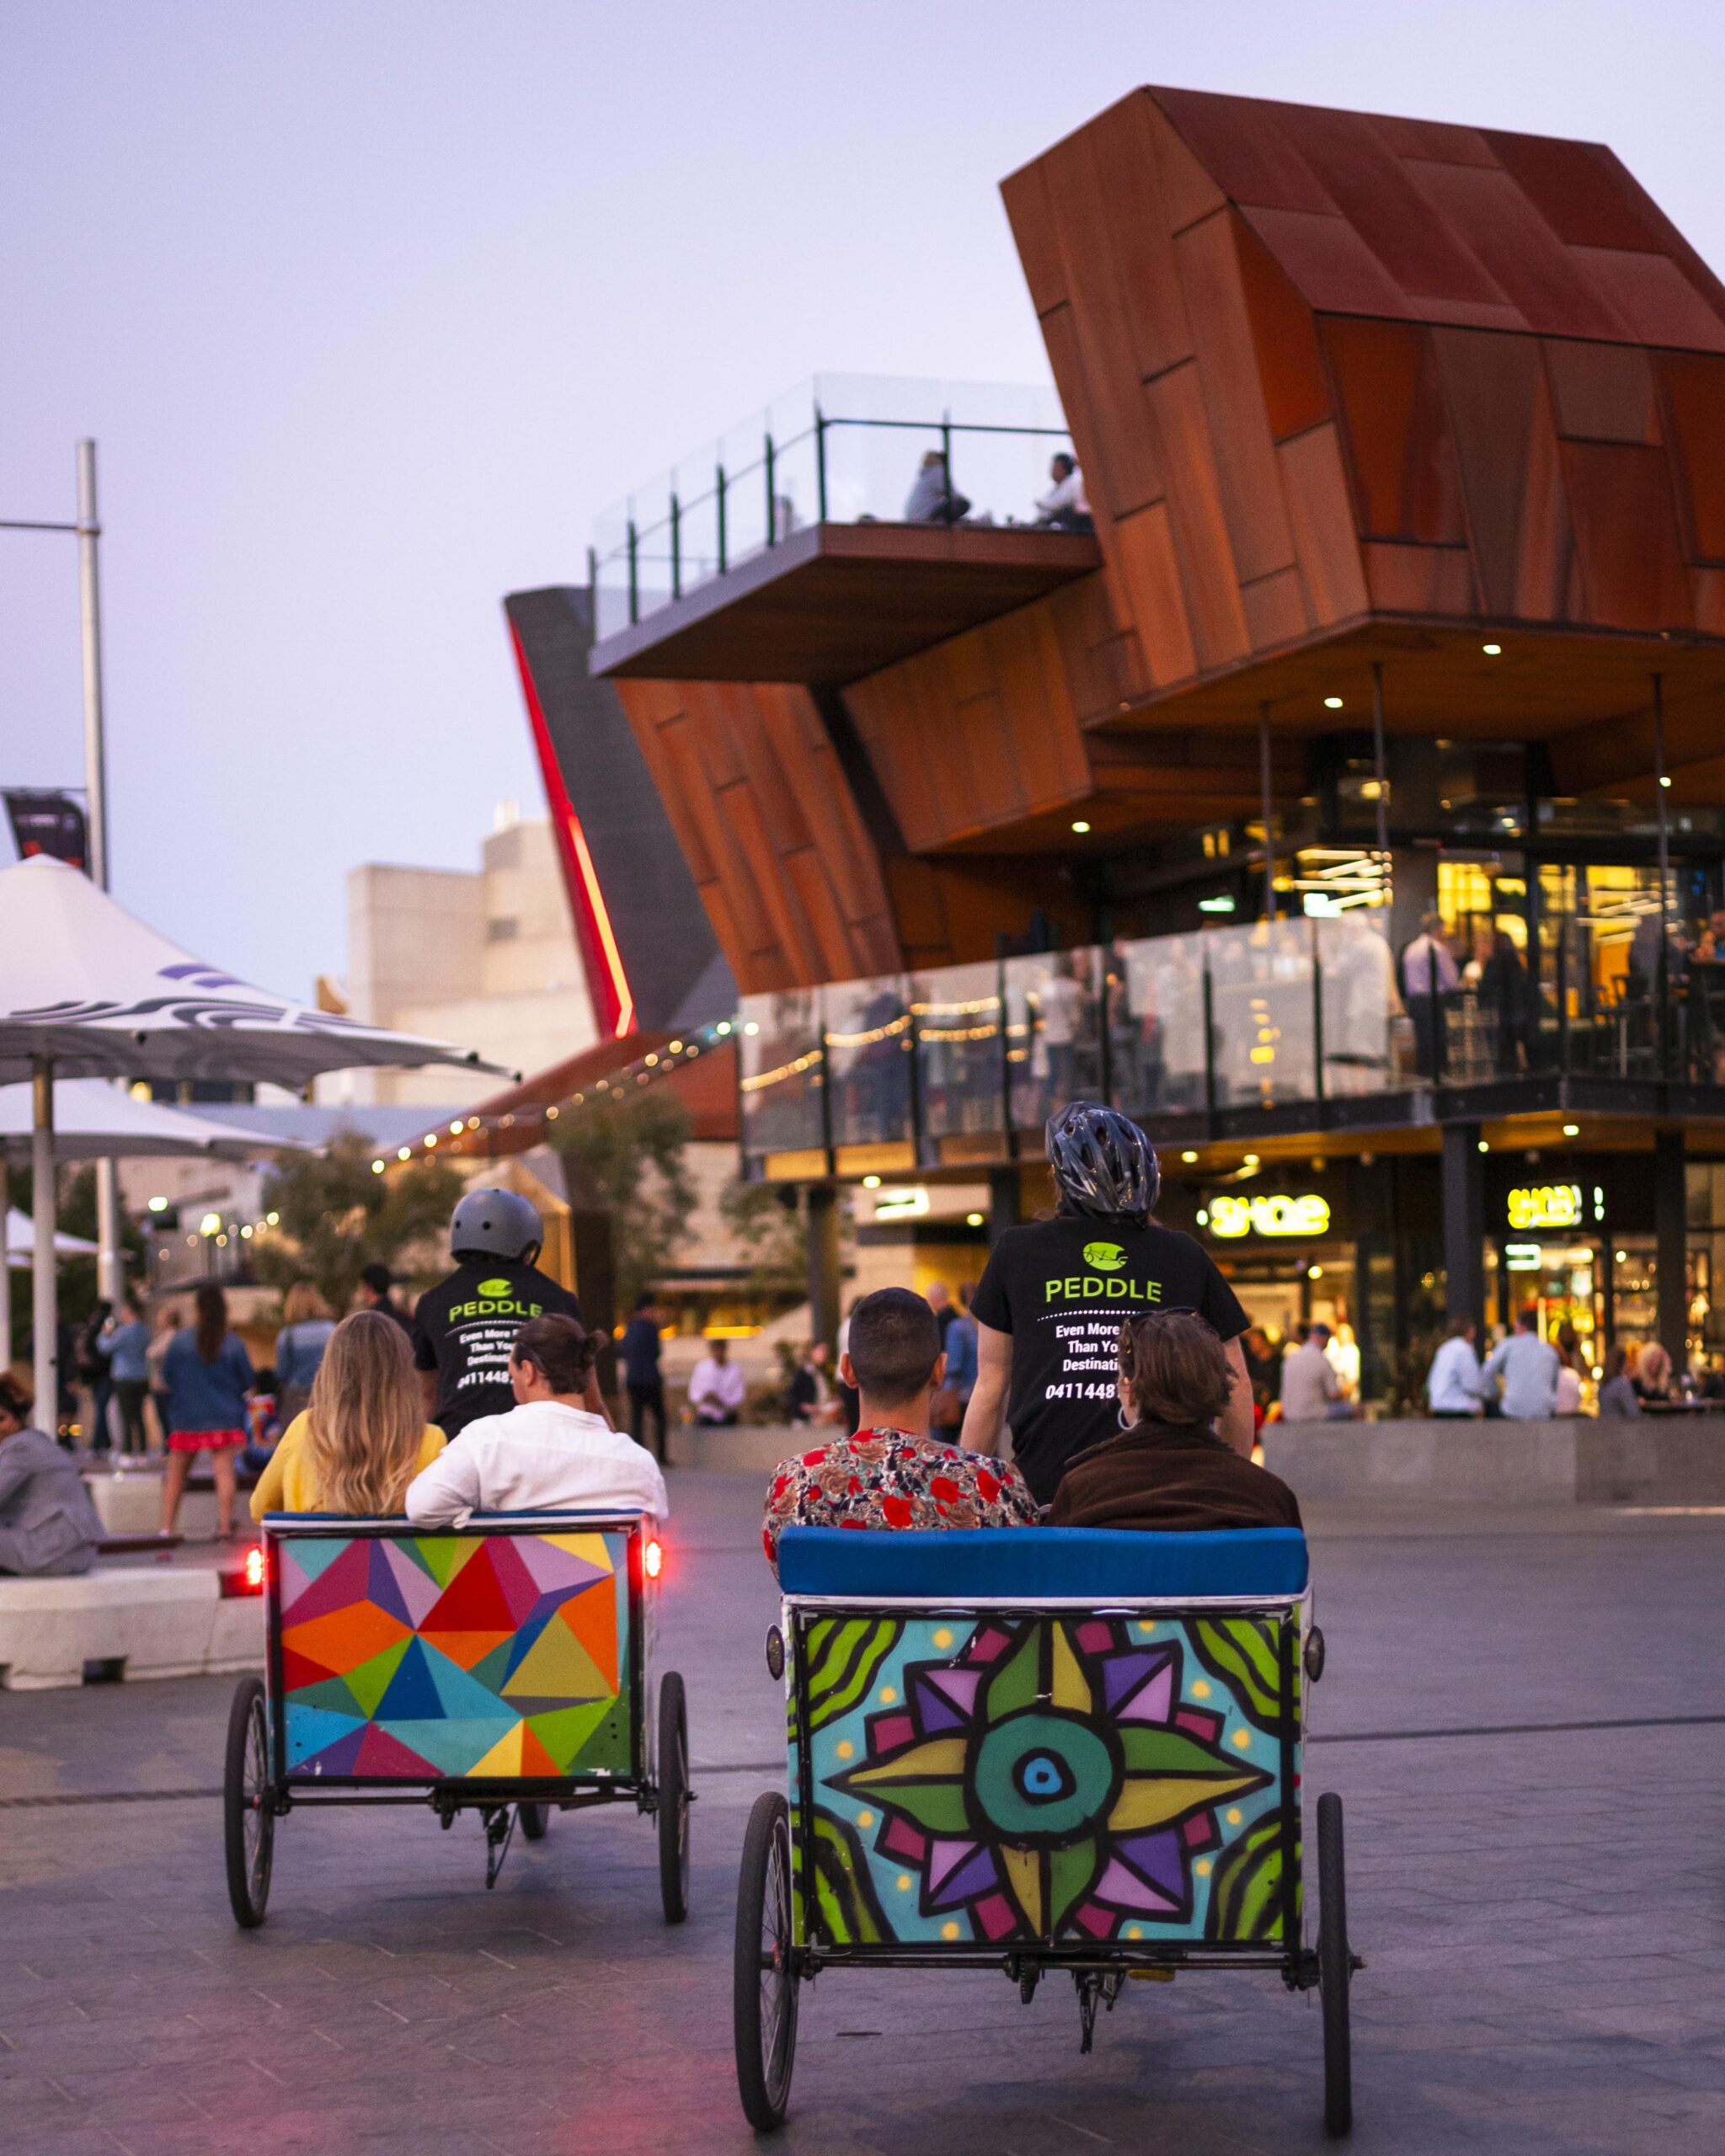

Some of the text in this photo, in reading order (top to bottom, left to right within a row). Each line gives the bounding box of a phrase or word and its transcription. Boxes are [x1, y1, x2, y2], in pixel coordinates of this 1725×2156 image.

[1045, 1277, 1162, 1303] PEDDLE
[448, 1300, 542, 1322] PEDDLE
[459, 1331, 483, 1344] Even
[484, 1328, 510, 1339] More
[1055, 1322, 1120, 1338] Even More
[470, 1342, 494, 1353] Than
[1067, 1340, 1119, 1353] Than Yo
[1063, 1357, 1119, 1372] Destinati
[1045, 1383, 1119, 1400] 0411448
